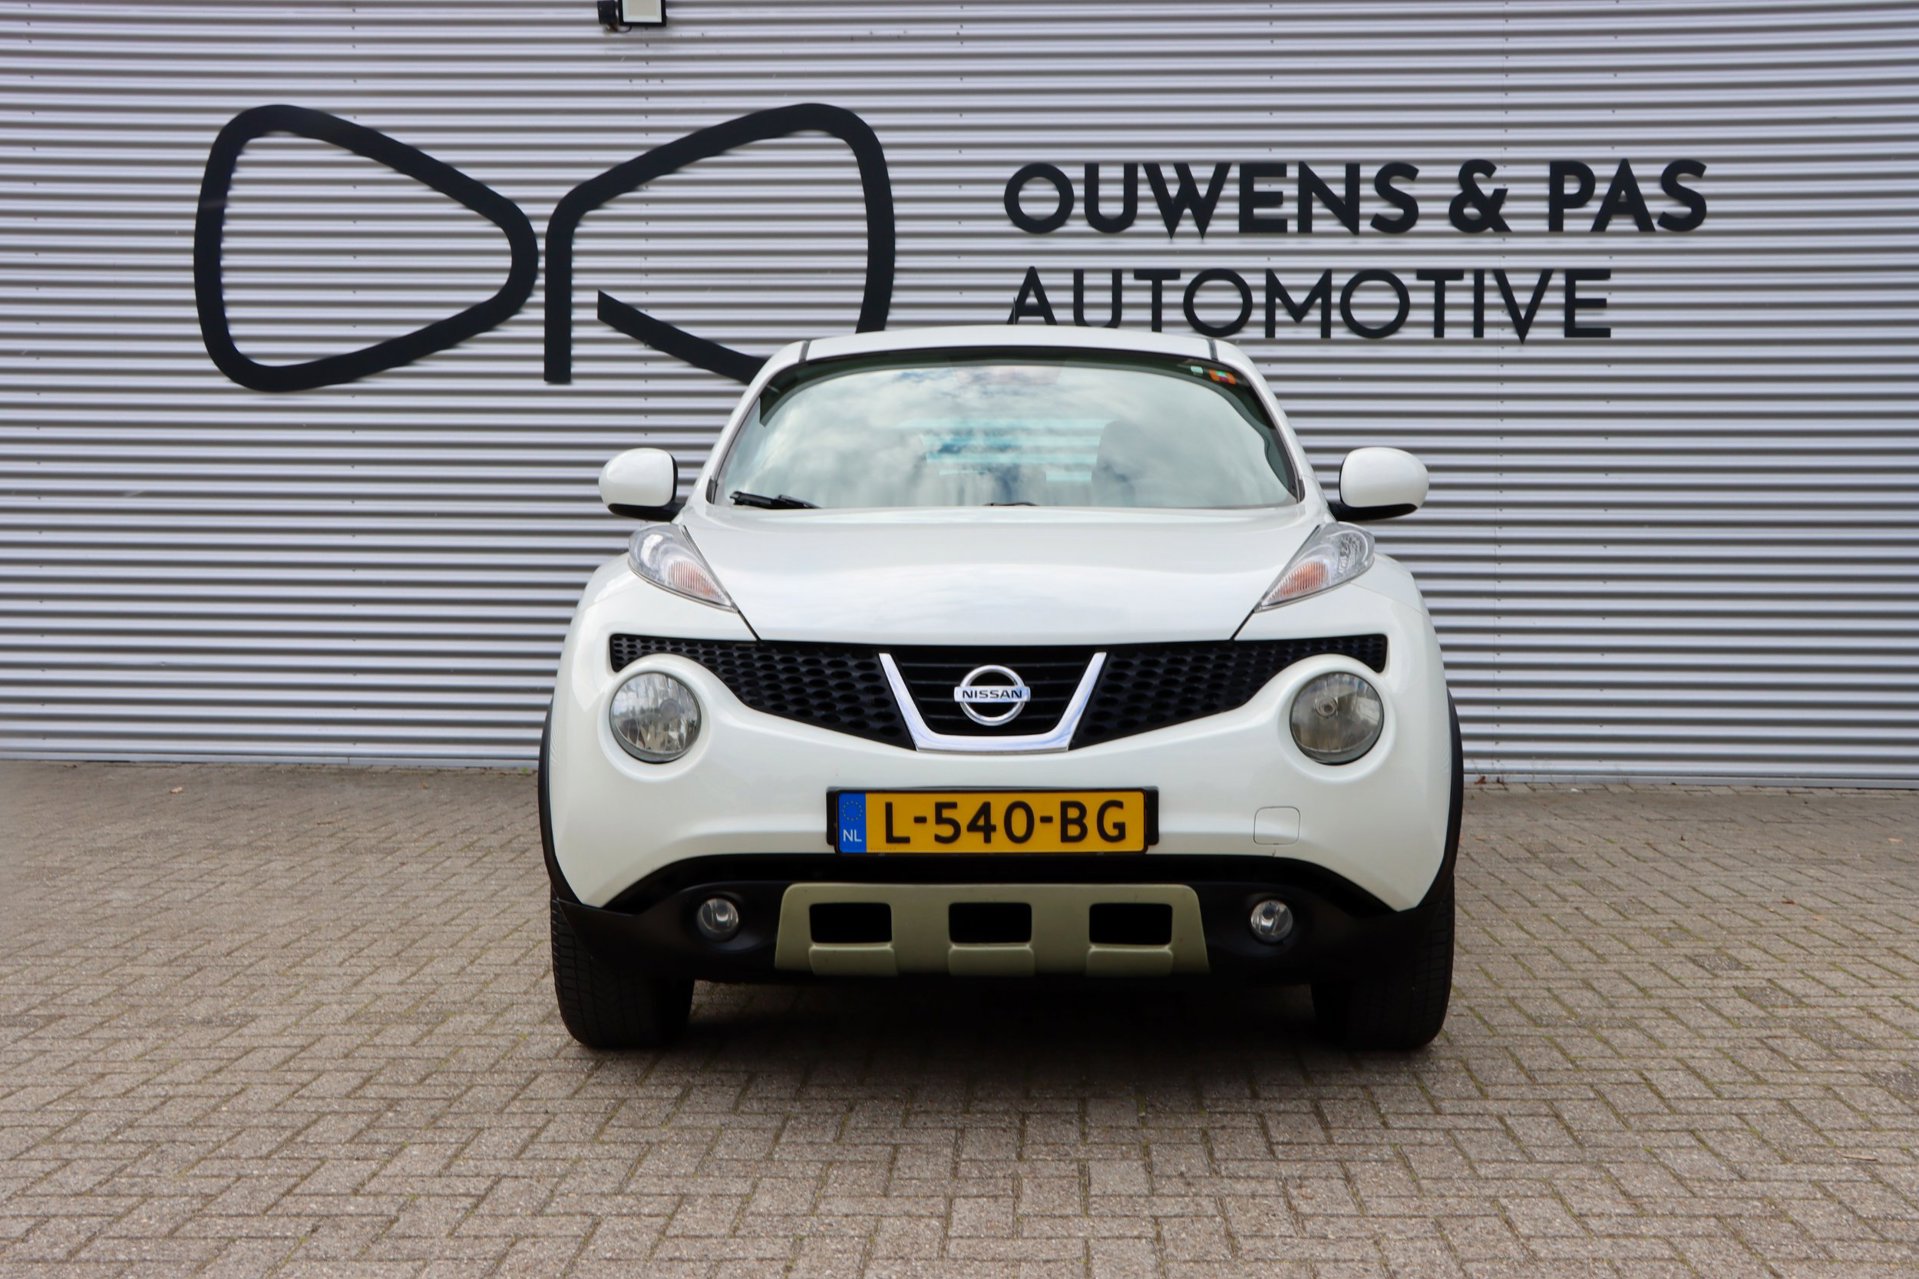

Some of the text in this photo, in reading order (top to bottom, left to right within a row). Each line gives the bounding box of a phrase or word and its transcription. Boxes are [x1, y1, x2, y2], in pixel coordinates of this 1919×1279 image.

[1003, 158, 1707, 240] OUWENS & PAS
[1007, 266, 1611, 344] AUTOMOTIVE
[962, 689, 1023, 699] NISSAN
[843, 829, 862, 842] NL
[884, 800, 1126, 844] L-540-BG
